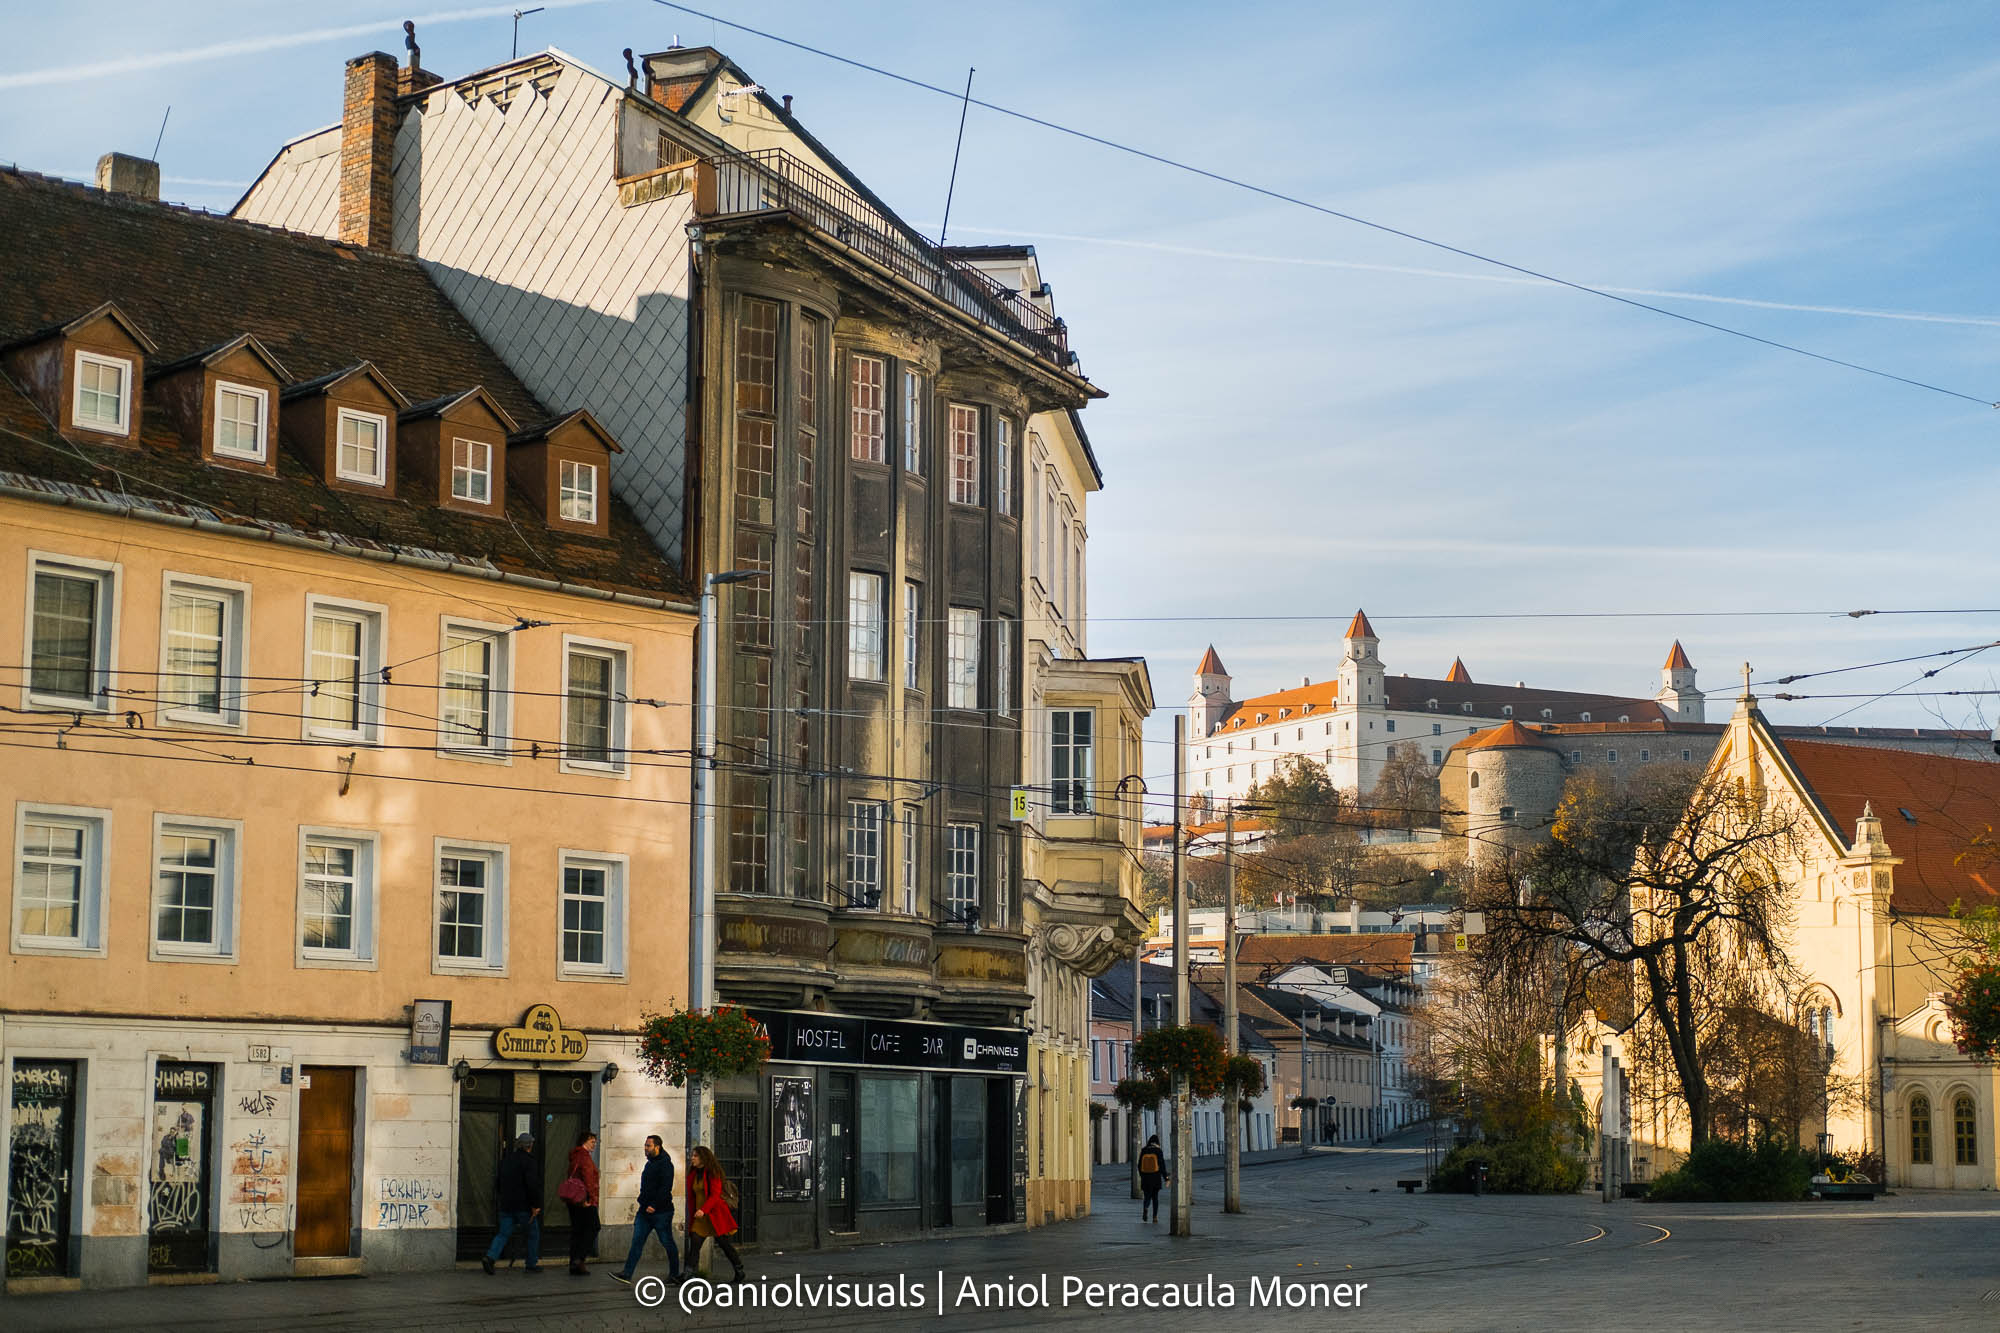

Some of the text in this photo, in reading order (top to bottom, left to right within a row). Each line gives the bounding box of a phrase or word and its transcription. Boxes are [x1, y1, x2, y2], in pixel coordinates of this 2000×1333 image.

[1014, 796, 1026, 811] 15
[1456, 938, 1466, 947] 20
[796, 1028, 847, 1049] HOSTEL
[870, 1033, 901, 1053] CAFE
[922, 1037, 944, 1055] BAR
[976, 1044, 1019, 1057] CHANNELS
[784, 1125, 794, 1141] Be
